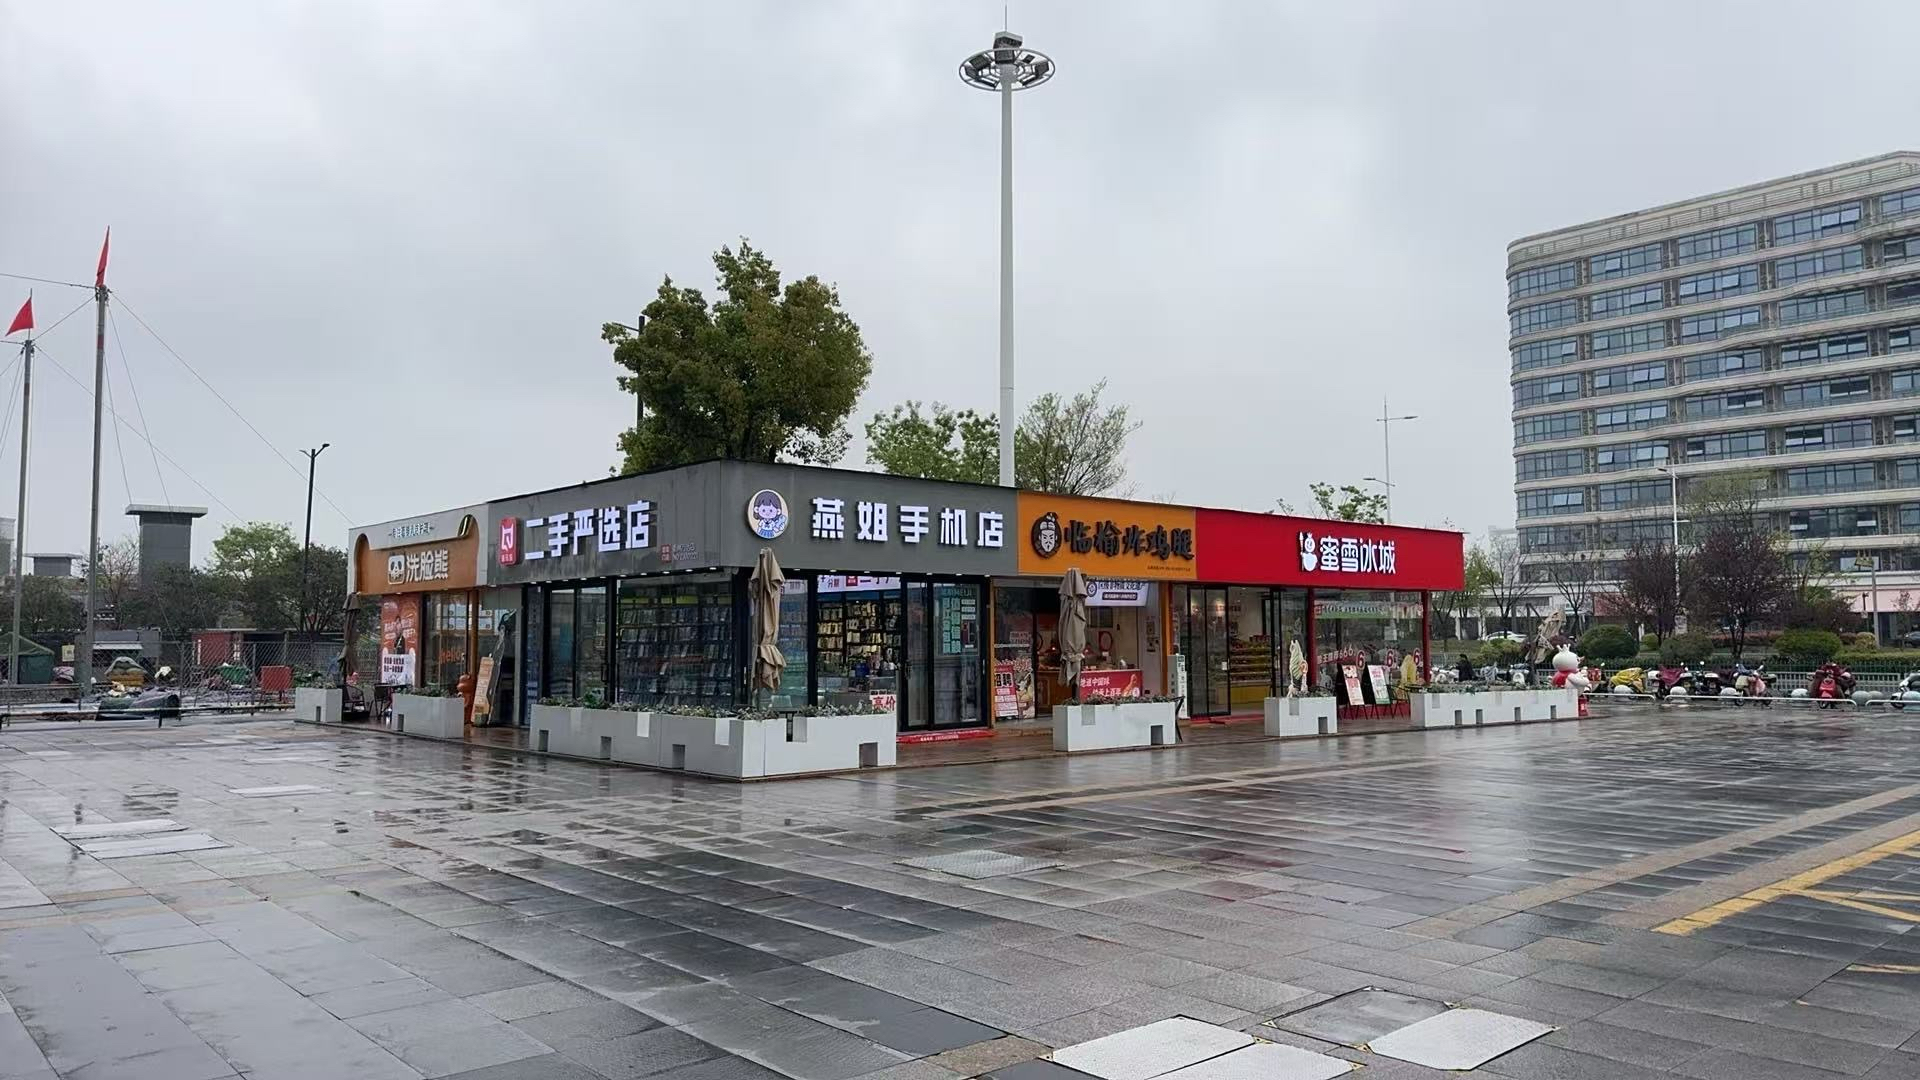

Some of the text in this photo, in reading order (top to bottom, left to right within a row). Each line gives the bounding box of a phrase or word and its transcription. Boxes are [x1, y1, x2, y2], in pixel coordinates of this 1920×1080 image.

[524, 500, 650, 560] 二手严选店
[812, 497, 1004, 548] 燕姐手机店
[406, 549, 449, 583] 洗脸熊
[1320, 535, 1396, 574] 蜜雪冰城
